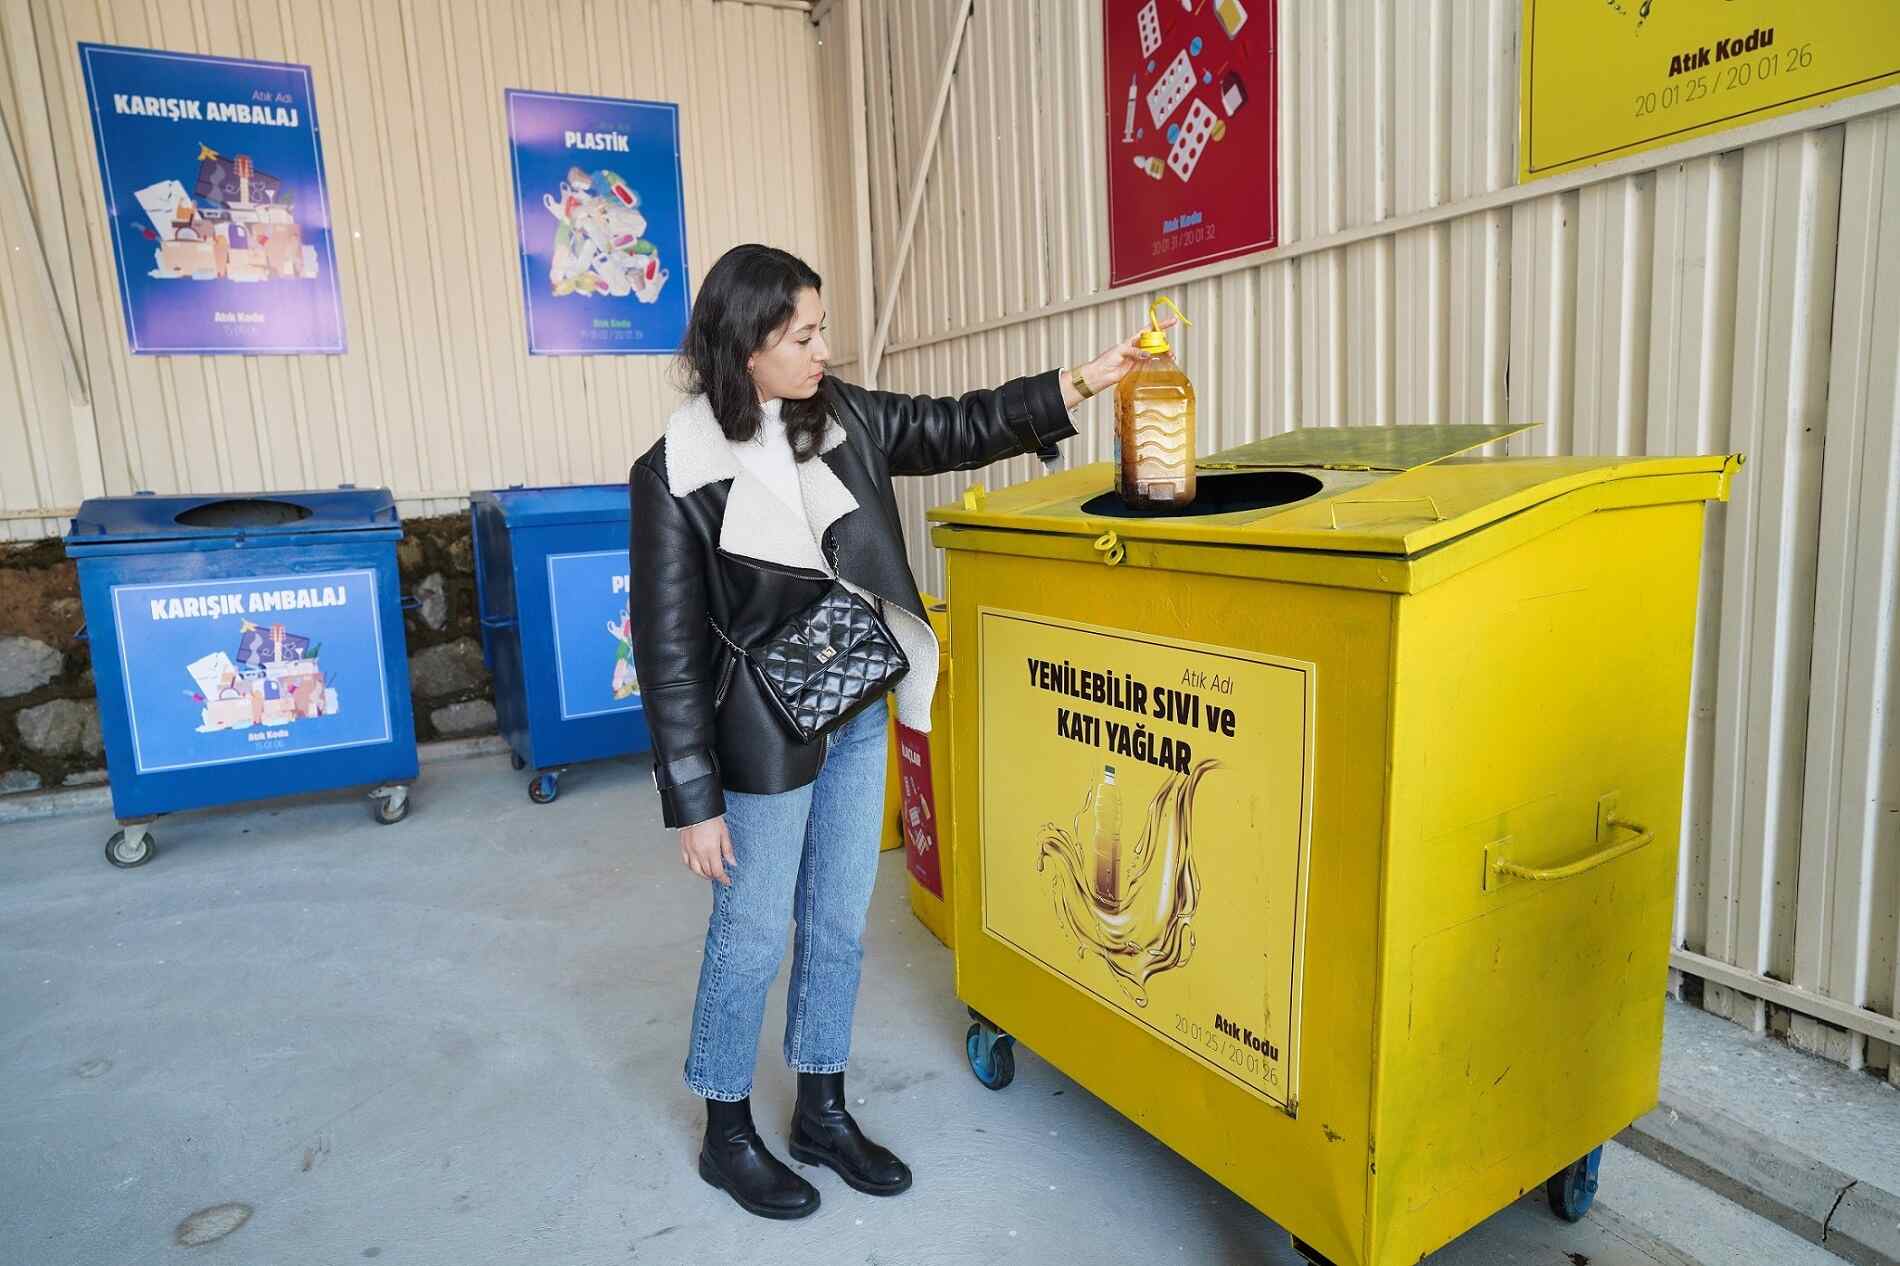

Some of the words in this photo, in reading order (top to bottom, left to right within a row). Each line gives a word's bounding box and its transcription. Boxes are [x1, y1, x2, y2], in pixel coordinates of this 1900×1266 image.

[1668, 47, 1711, 78] Atık
[1715, 28, 1774, 62] Kodu
[1635, 92, 1656, 117] 20
[1662, 85, 1679, 109] 01
[1686, 76, 1707, 102] 25
[1726, 63, 1751, 90] 20
[1758, 54, 1778, 80] 01
[1786, 43, 1813, 72] 26
[113, 94, 202, 122] KARIŞIK
[207, 102, 299, 128] AMBALAJ
[564, 130, 630, 152] PLASTİK
[151, 594, 244, 620] KARIŞIK
[249, 586, 347, 613] AMBALAJ
[1027, 657, 1147, 715] YENİLEBİLİR
[1153, 686, 1199, 728] SIVI
[1205, 704, 1236, 738] ve
[1181, 668, 1206, 689] Atık
[1211, 673, 1234, 695] Adı
[1057, 707, 1100, 748] KATI
[1105, 720, 1192, 776] YAĞLAR
[1176, 1013, 1188, 1034] 20
[1191, 1023, 1202, 1042] 01
[1206, 1031, 1218, 1053] 25
[1229, 1045, 1243, 1066] 20
[1247, 1052, 1259, 1075] 01
[1262, 1063, 1278, 1086] 26
[1214, 1013, 1240, 1041] Atık
[1243, 1028, 1279, 1062] Kodu
